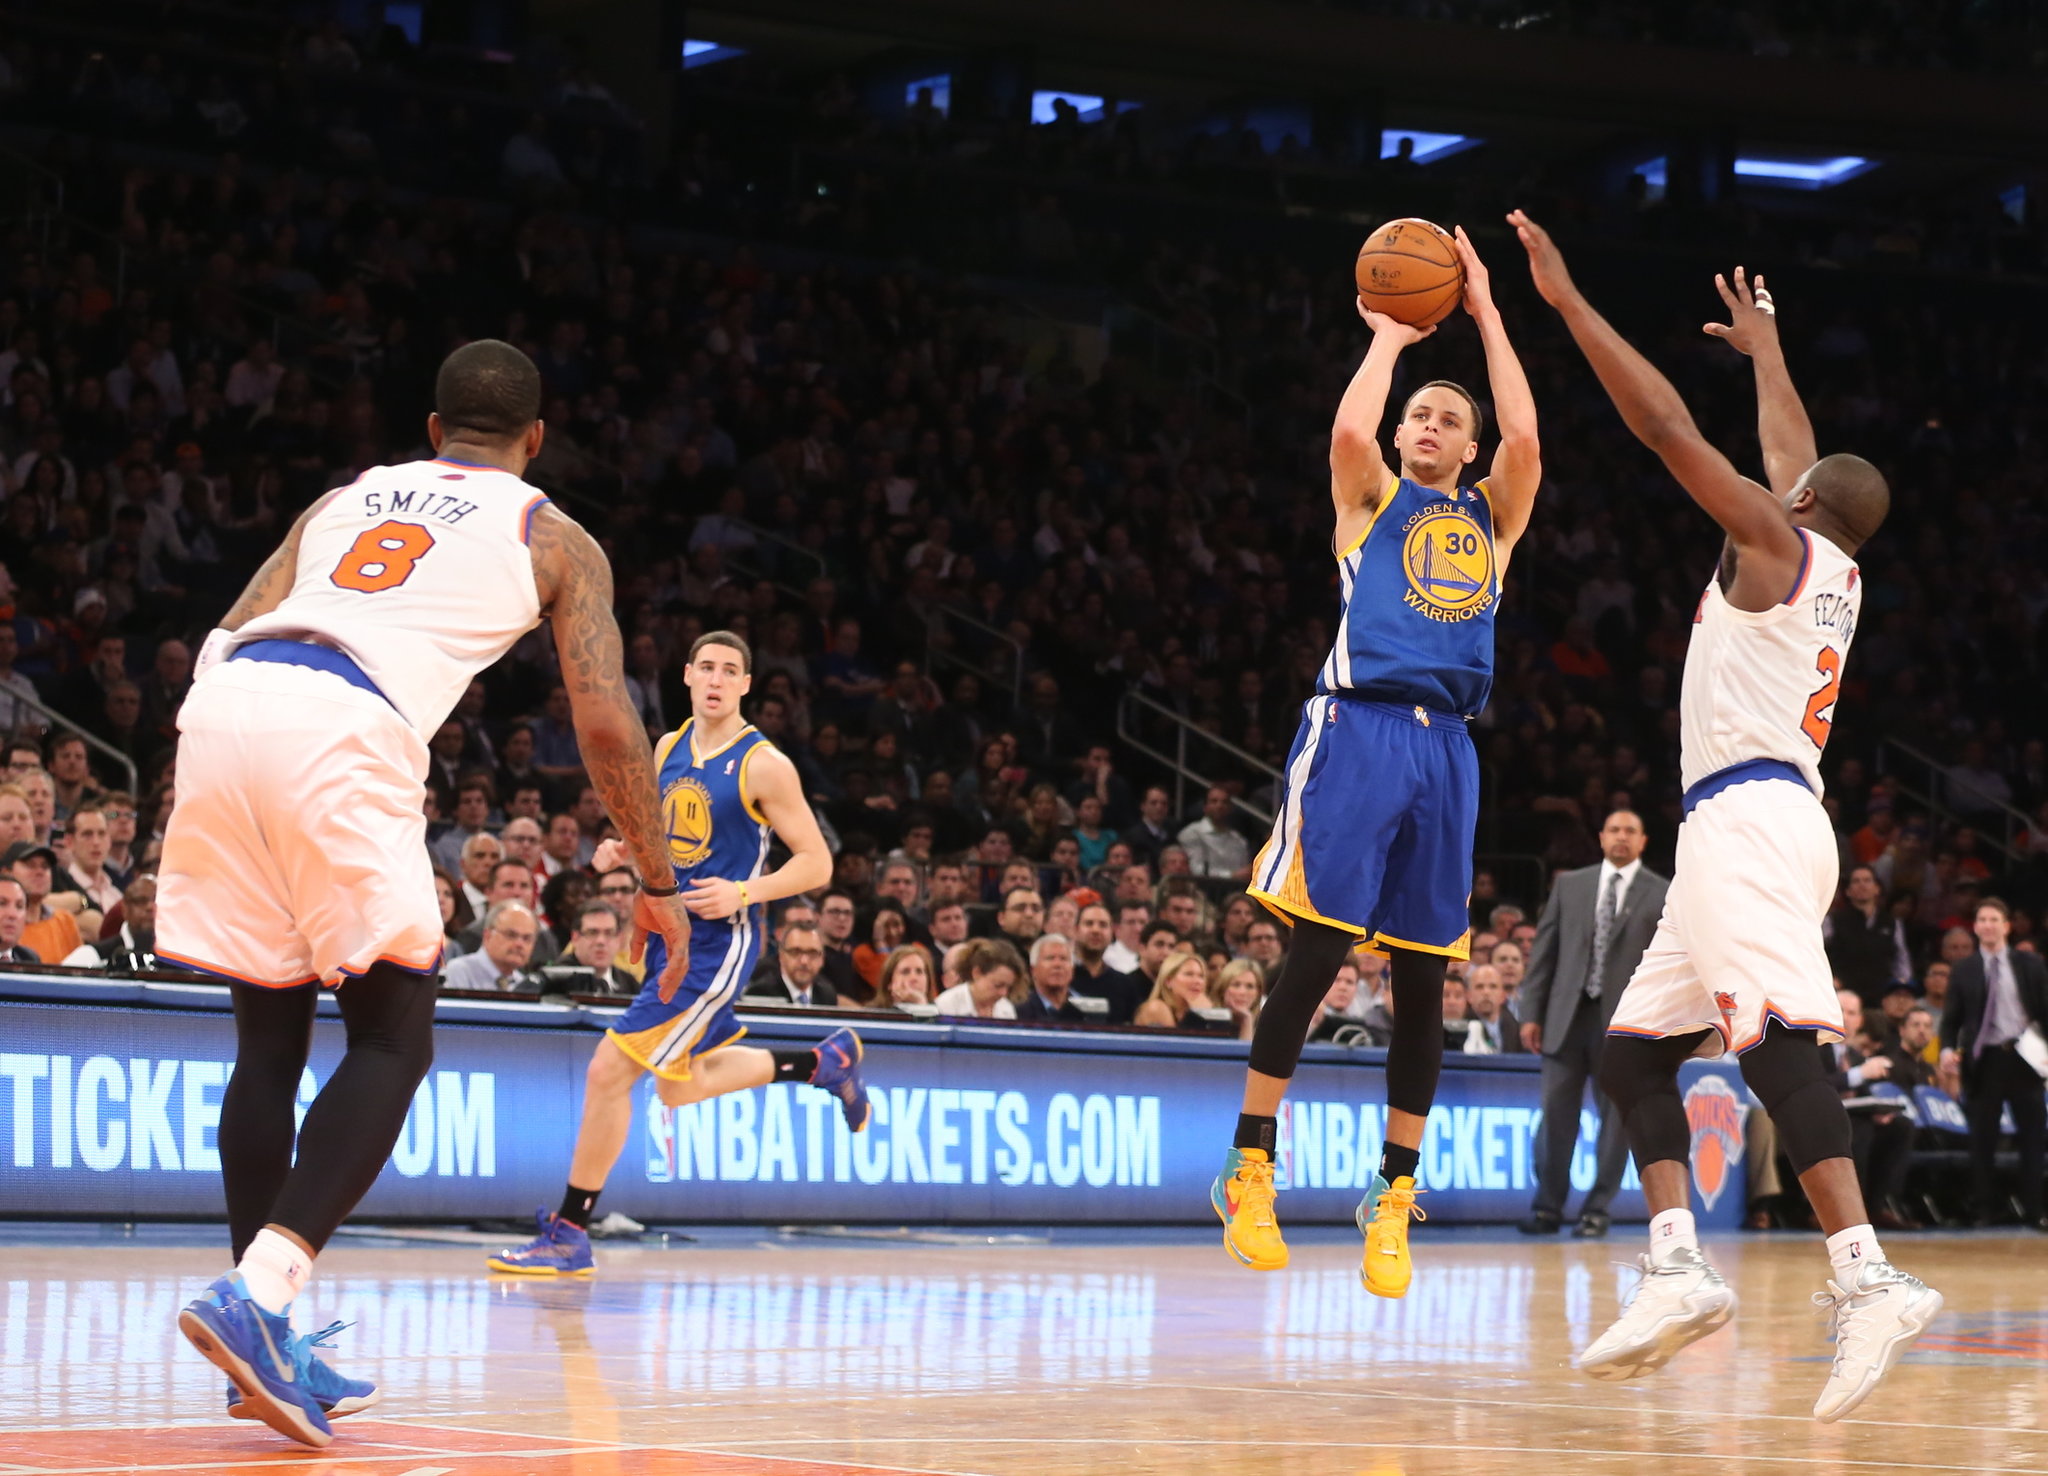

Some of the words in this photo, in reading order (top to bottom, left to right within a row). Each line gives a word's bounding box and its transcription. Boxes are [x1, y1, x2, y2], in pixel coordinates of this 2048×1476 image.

[365, 490, 478, 524] SMITH
[1402, 503, 1453, 532] GOLDEN
[329, 519, 436, 594] 8
[1445, 532, 1478, 556] 30
[1402, 588, 1494, 623] WARRIORS
[1800, 644, 1840, 750] 2
[686, 801, 697, 820] 11
[677, 1082, 1161, 1188] NBATICKETS.COM
